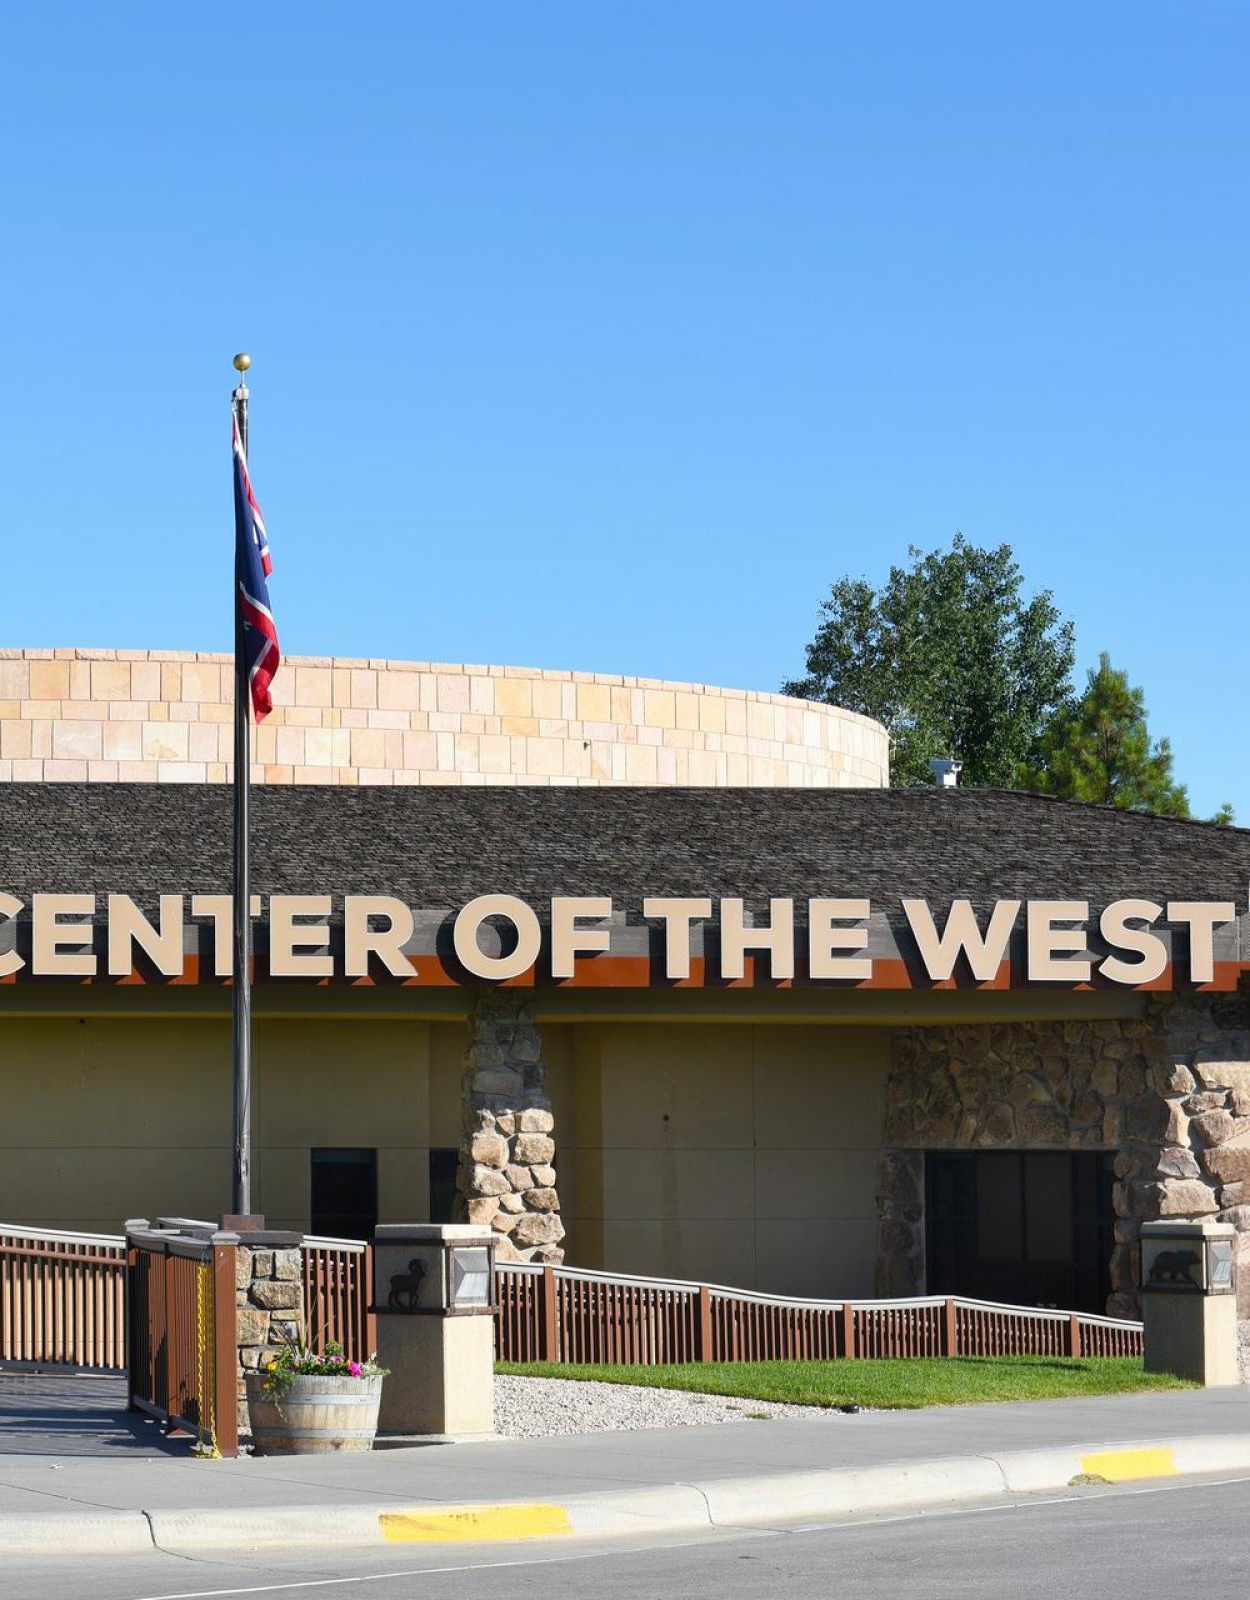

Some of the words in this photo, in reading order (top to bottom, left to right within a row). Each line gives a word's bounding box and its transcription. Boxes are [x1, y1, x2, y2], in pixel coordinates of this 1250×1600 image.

[453, 893, 612, 980] OF
[643, 898, 873, 980] THE
[901, 899, 1236, 984] WEST
